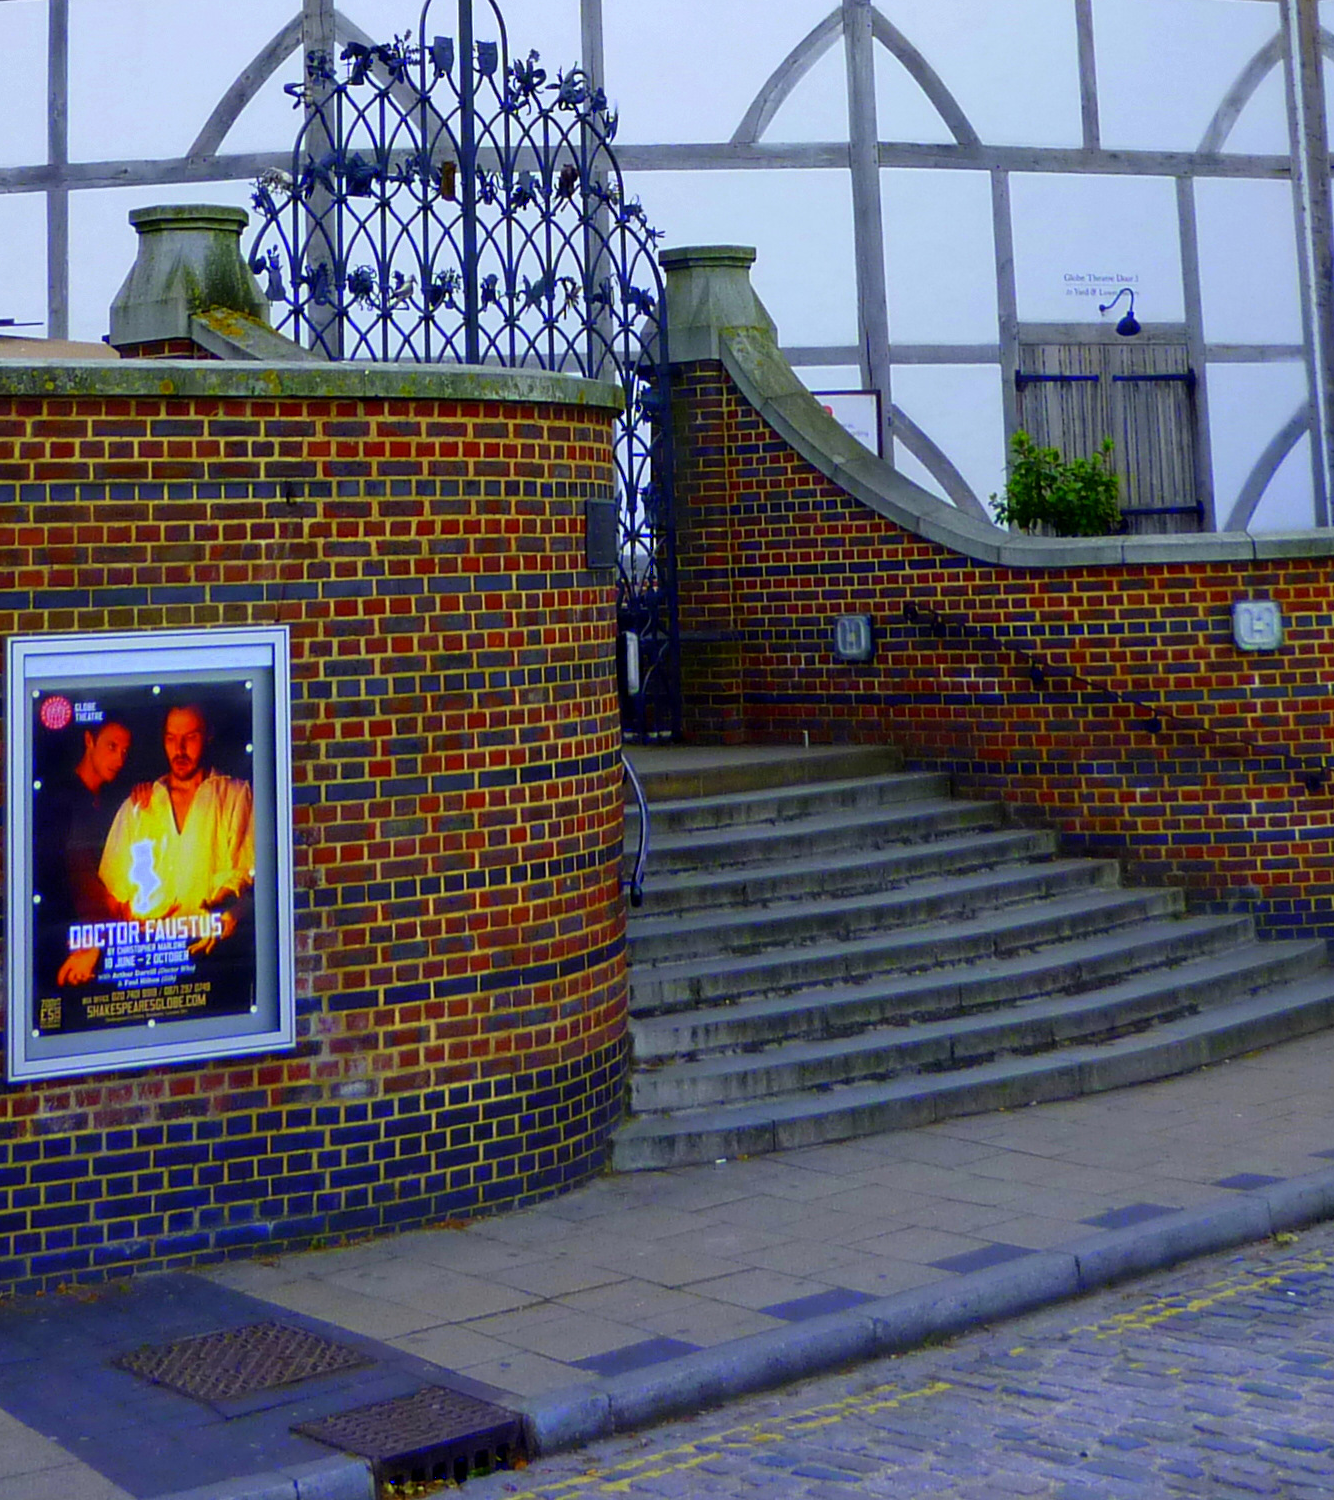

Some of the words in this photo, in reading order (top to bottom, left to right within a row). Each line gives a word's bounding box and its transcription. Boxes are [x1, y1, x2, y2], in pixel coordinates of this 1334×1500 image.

[69, 921, 140, 949] DOCTOR
[145, 912, 222, 944] FAUSTUS
[117, 943, 156, 954] CHRISTOPHER
[158, 940, 186, 951] MARLOWE
[115, 955, 136, 968] JUNE
[146, 954, 151, 964] 2
[153, 949, 189, 964] OCTOBER
[87, 994, 206, 1018] SHAKESPEARESGLOBE.COM
